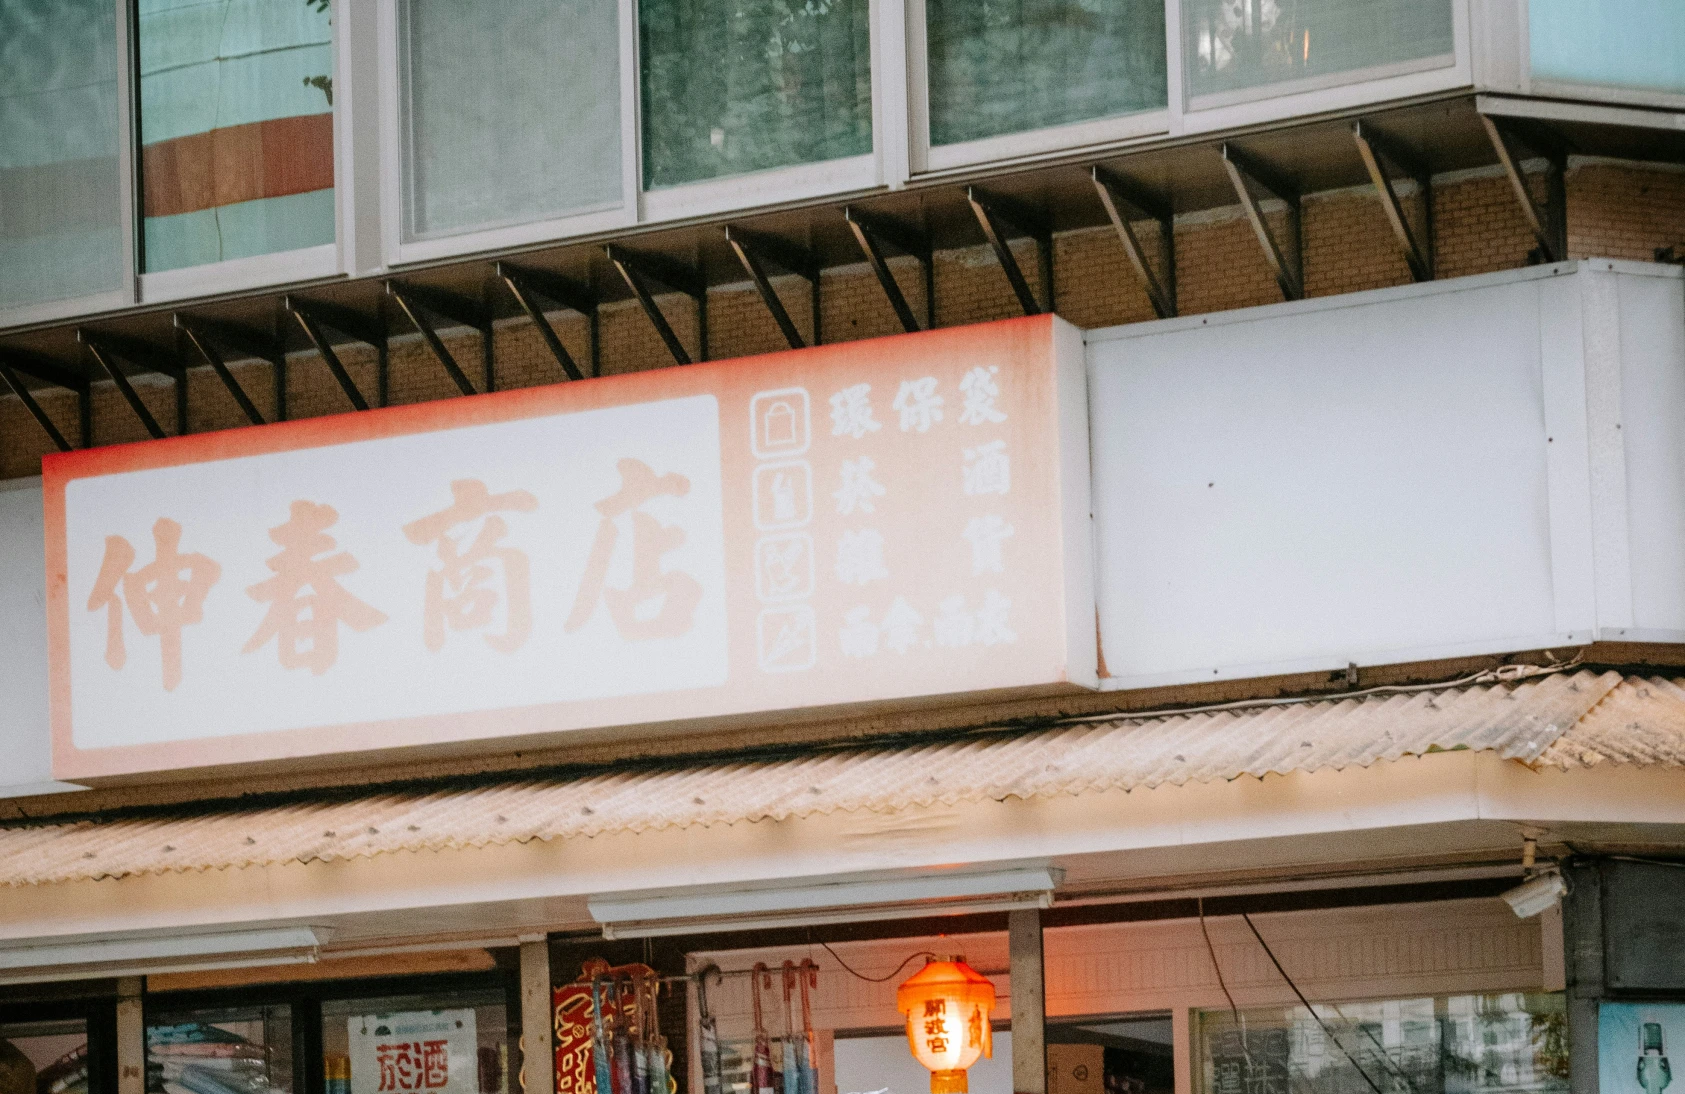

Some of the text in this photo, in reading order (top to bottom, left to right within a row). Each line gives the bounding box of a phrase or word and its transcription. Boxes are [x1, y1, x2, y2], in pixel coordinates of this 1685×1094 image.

[828, 364, 1008, 438] 環保袋
[87, 457, 703, 692] 伸春商店
[376, 1039, 449, 1091] 菸酒
